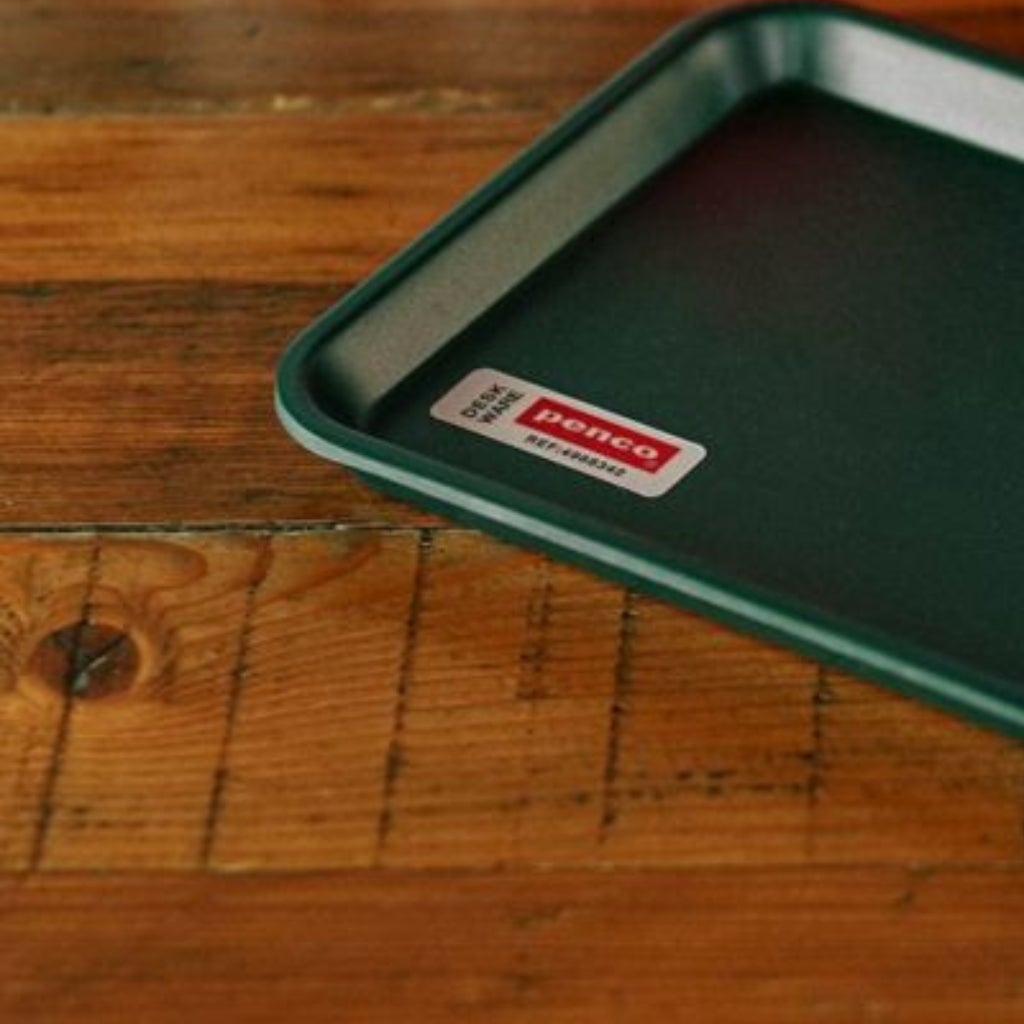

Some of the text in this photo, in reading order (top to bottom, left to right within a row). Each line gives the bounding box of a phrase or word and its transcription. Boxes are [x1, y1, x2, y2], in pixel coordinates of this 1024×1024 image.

[459, 382, 509, 419] DESK
[476, 390, 526, 425] WARE
[532, 408, 660, 460] penco
